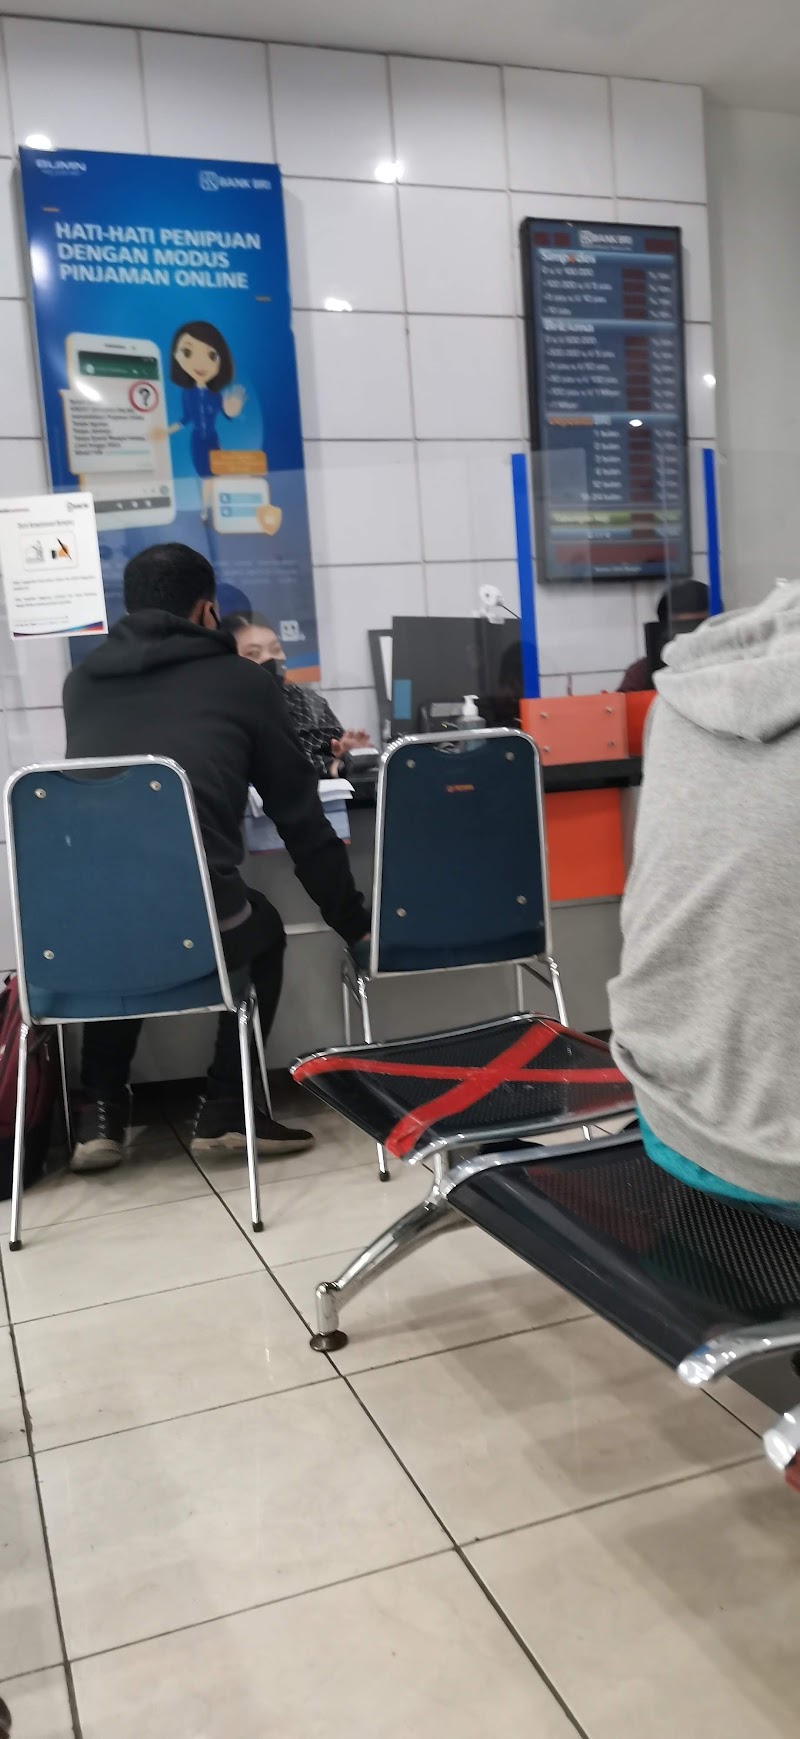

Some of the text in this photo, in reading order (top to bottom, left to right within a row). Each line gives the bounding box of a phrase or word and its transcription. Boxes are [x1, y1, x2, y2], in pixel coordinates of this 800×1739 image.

[36, 159, 87, 172] BUMN
[219, 177, 272, 190] BANK BRI
[55, 221, 261, 250] HATI-HATI PENIPUAN
[57, 243, 230, 269] DENGAN MODUS
[59, 264, 249, 290] PINJAMAN ONLINE
